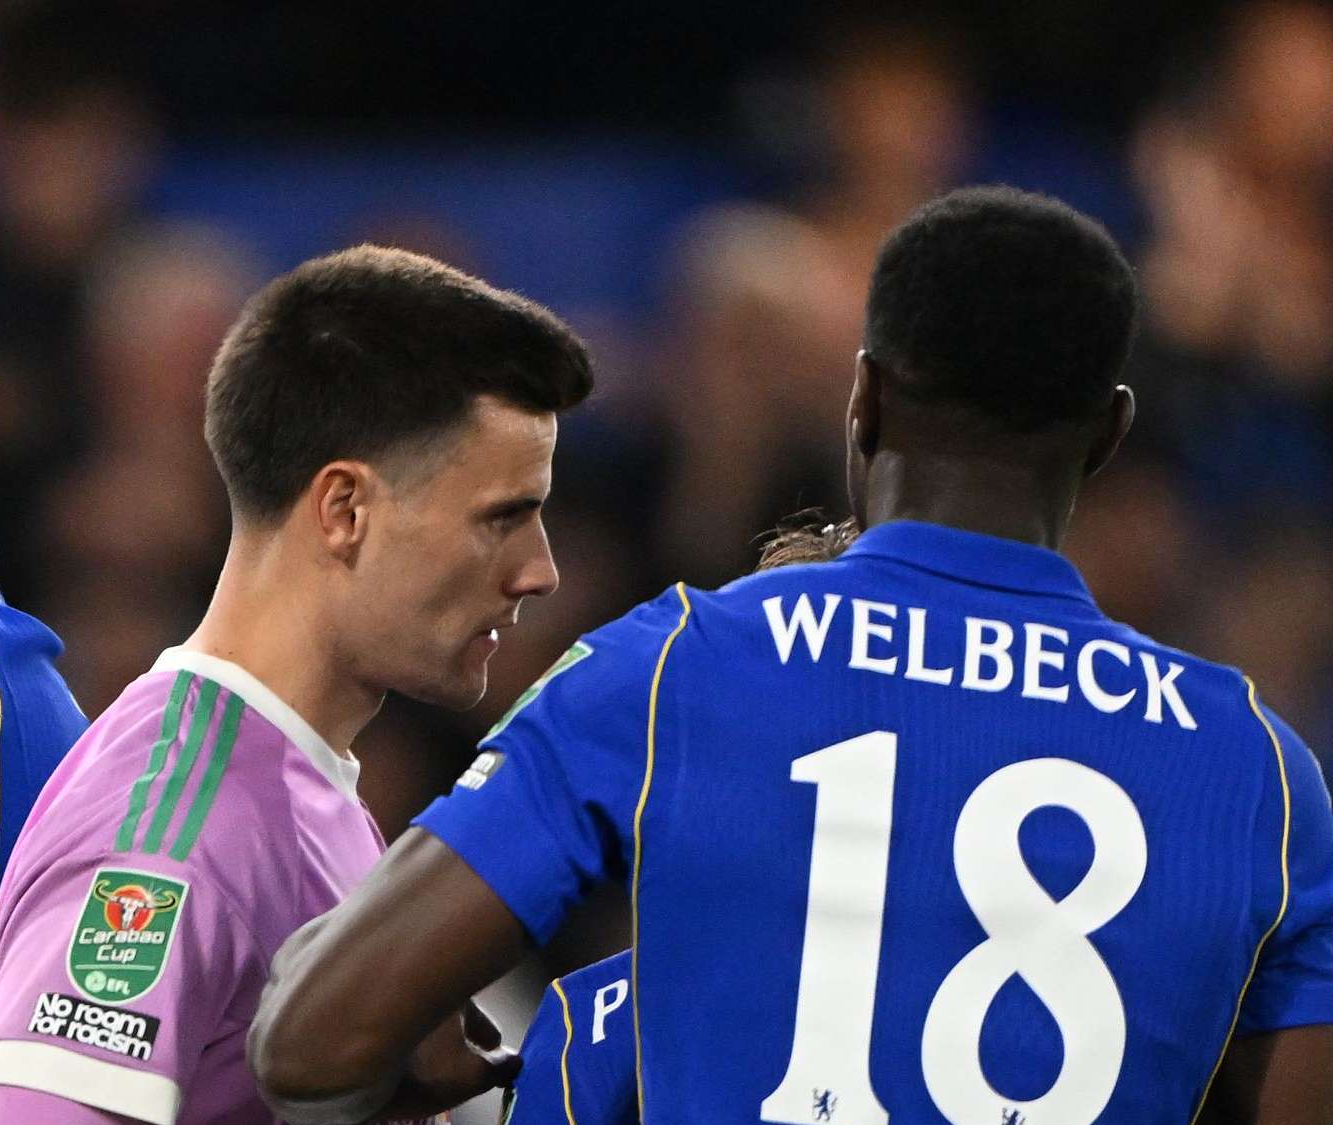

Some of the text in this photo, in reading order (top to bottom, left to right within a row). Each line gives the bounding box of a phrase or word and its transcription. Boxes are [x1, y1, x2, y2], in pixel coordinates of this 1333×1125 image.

[762, 592, 1198, 730] WELBECK
[78, 927, 165, 945] Carabao
[96, 944, 137, 963] Cup
[107, 978, 131, 995] EFL
[37, 992, 147, 1039] No room
[28, 1011, 152, 1061] for racism
